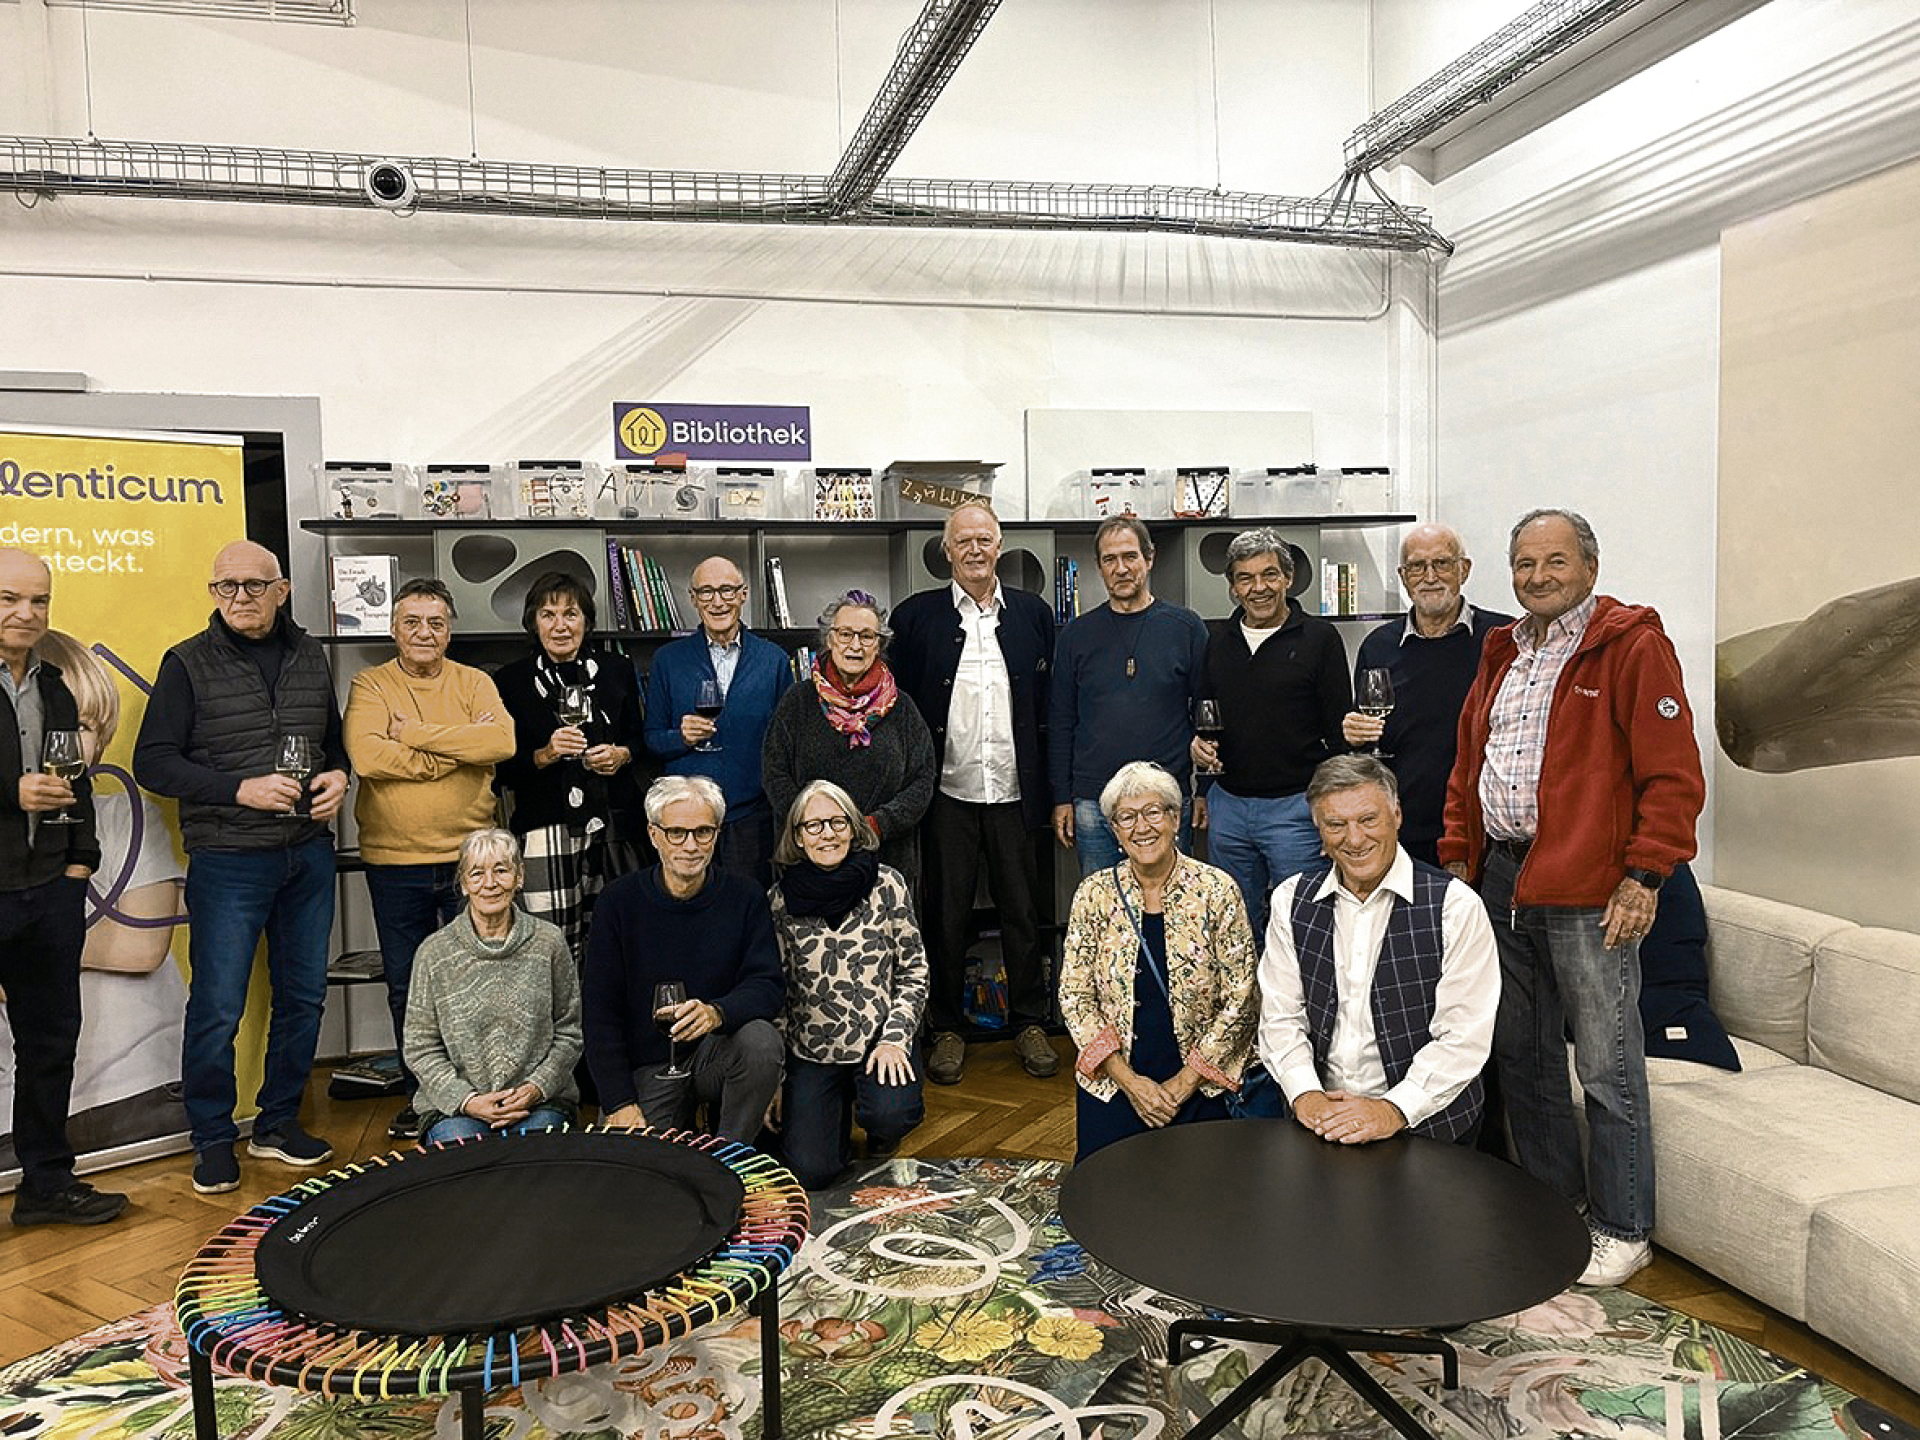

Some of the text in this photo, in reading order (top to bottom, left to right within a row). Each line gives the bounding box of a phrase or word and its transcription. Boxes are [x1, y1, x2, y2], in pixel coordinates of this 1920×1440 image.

[672, 420, 806, 445] Bibliothek
[0, 521, 155, 549] dern, was
